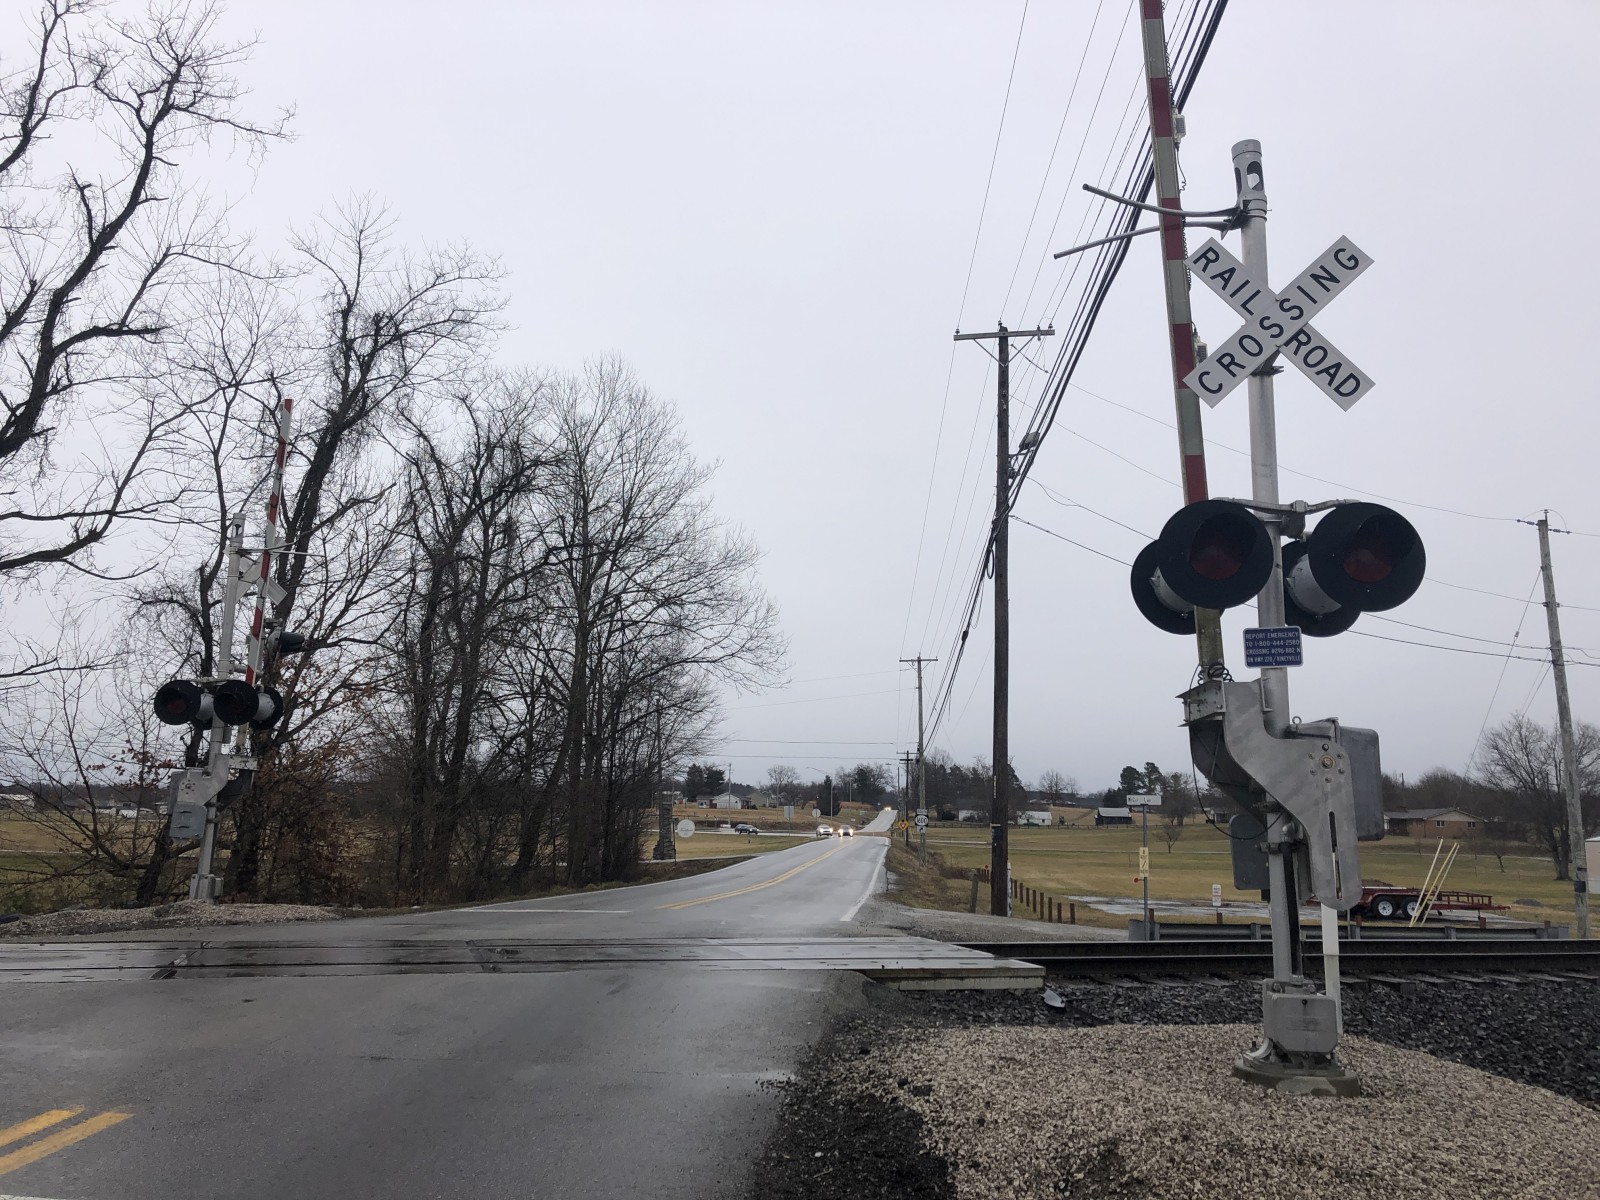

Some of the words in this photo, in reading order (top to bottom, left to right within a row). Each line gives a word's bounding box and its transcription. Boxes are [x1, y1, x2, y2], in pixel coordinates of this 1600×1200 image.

[1192, 246, 1262, 316] RAIL
[1198, 248, 1360, 395] CROSSING
[1283, 328, 1361, 398] ROAD
